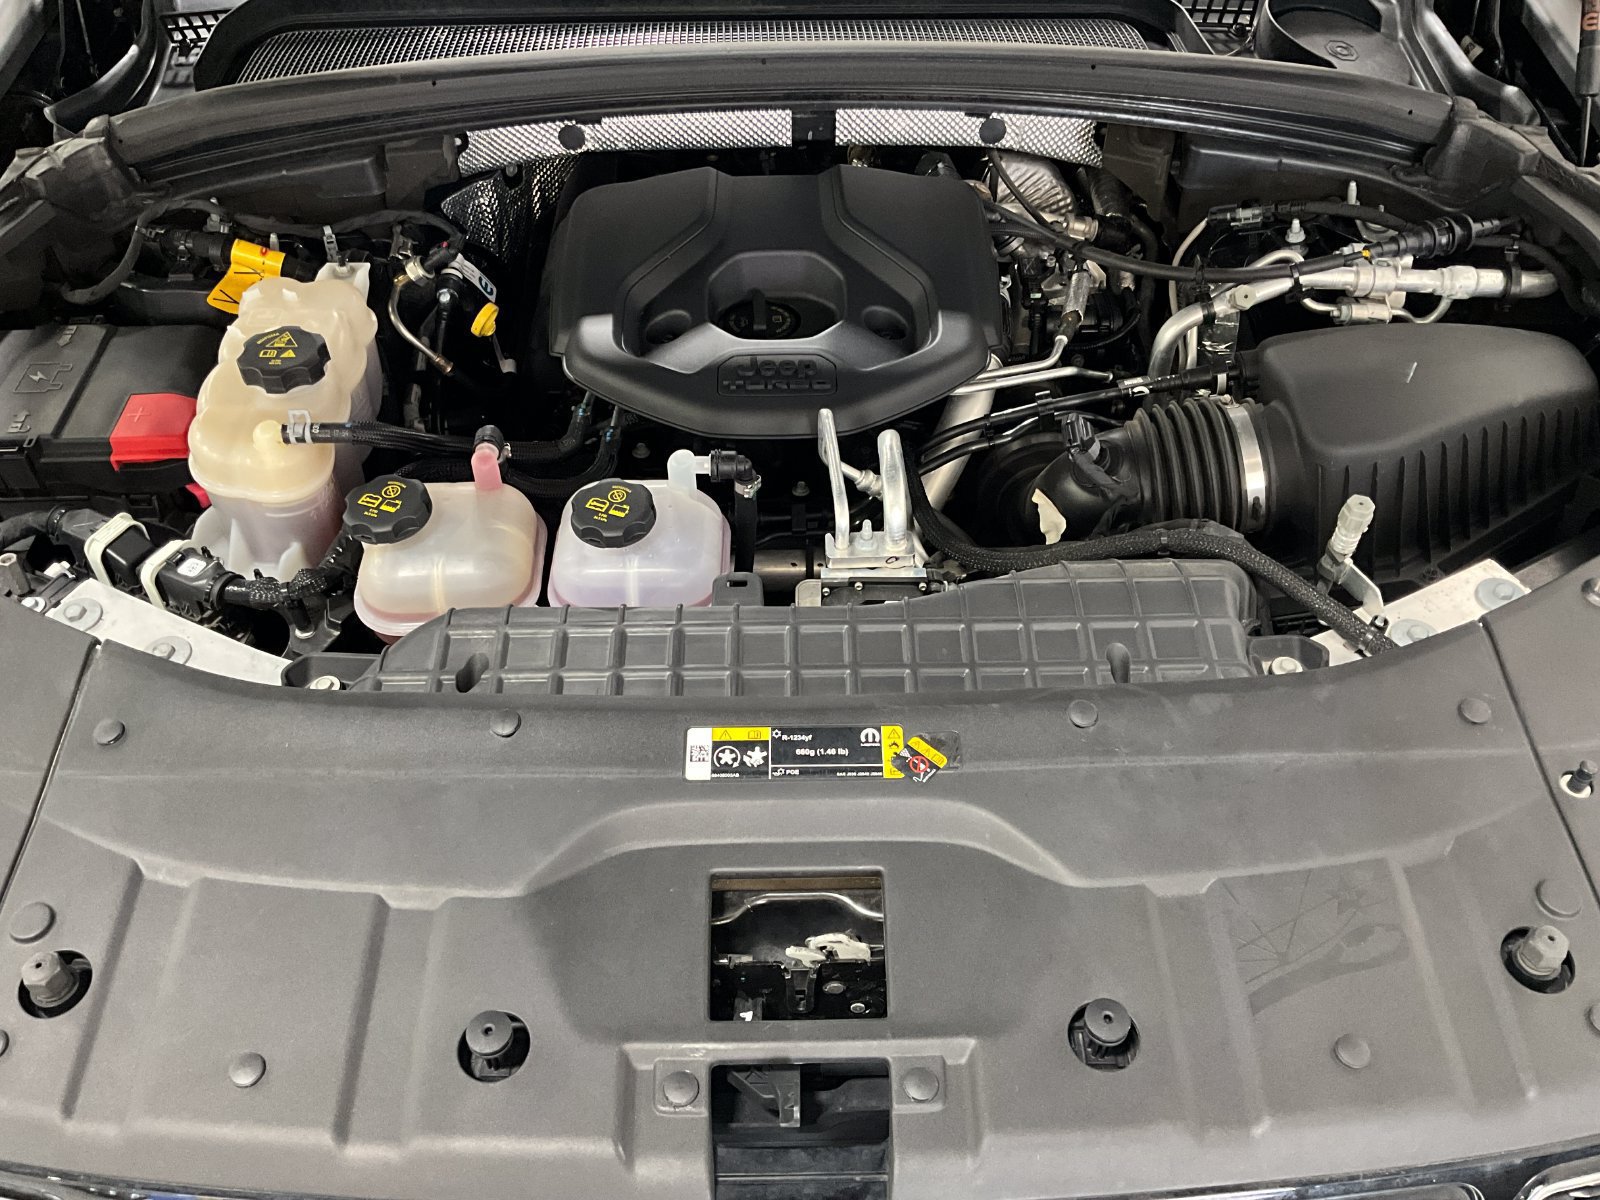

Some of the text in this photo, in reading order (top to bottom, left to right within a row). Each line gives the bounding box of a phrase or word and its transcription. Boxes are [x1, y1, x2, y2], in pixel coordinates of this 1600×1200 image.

[736, 356, 818, 379] Jeep
[781, 734, 813, 742] R-1234yf
[837, 747, 849, 757] lb)
